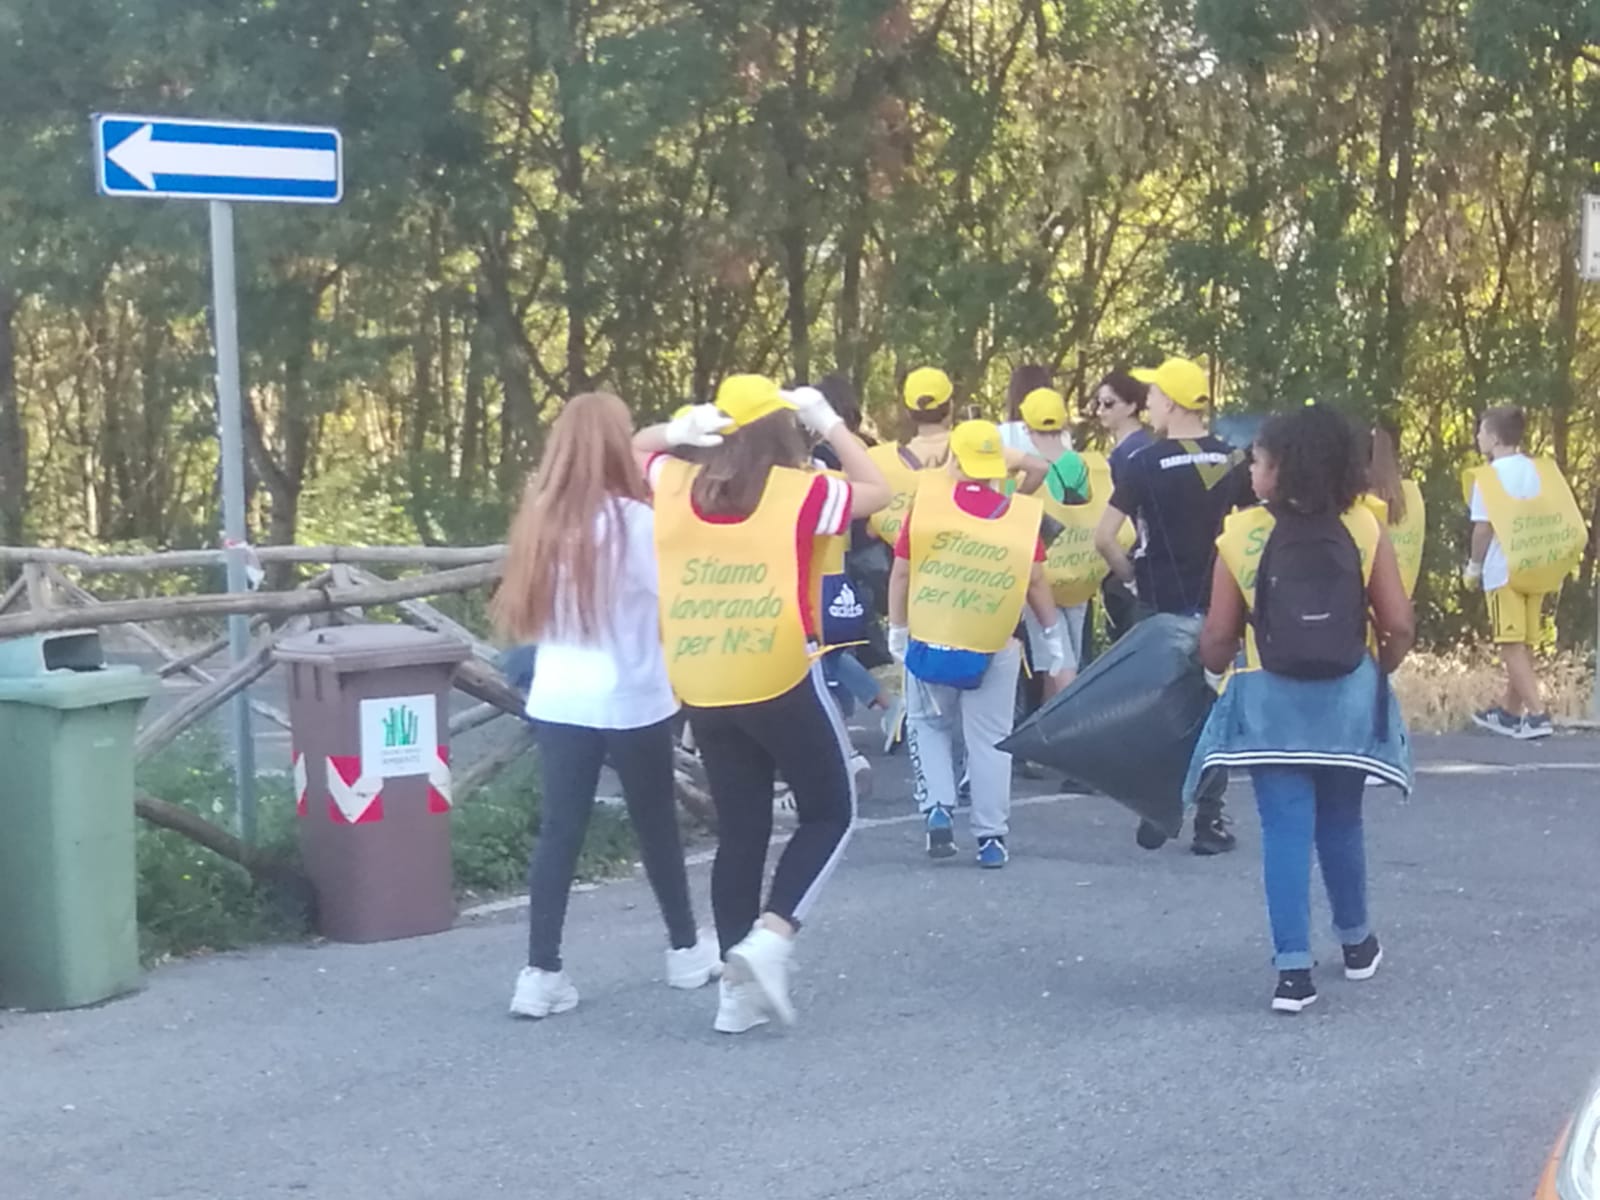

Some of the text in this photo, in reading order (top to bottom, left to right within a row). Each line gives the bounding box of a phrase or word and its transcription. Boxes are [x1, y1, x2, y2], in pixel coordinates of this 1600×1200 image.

[931, 530, 1009, 562] Stiamo
[1053, 528, 1094, 549] Stia
[681, 556, 767, 586] Stiamo
[918, 554, 1016, 590] lavorando
[670, 586, 783, 619] lavorando
[913, 586, 950, 606] per
[672, 635, 716, 663] per
